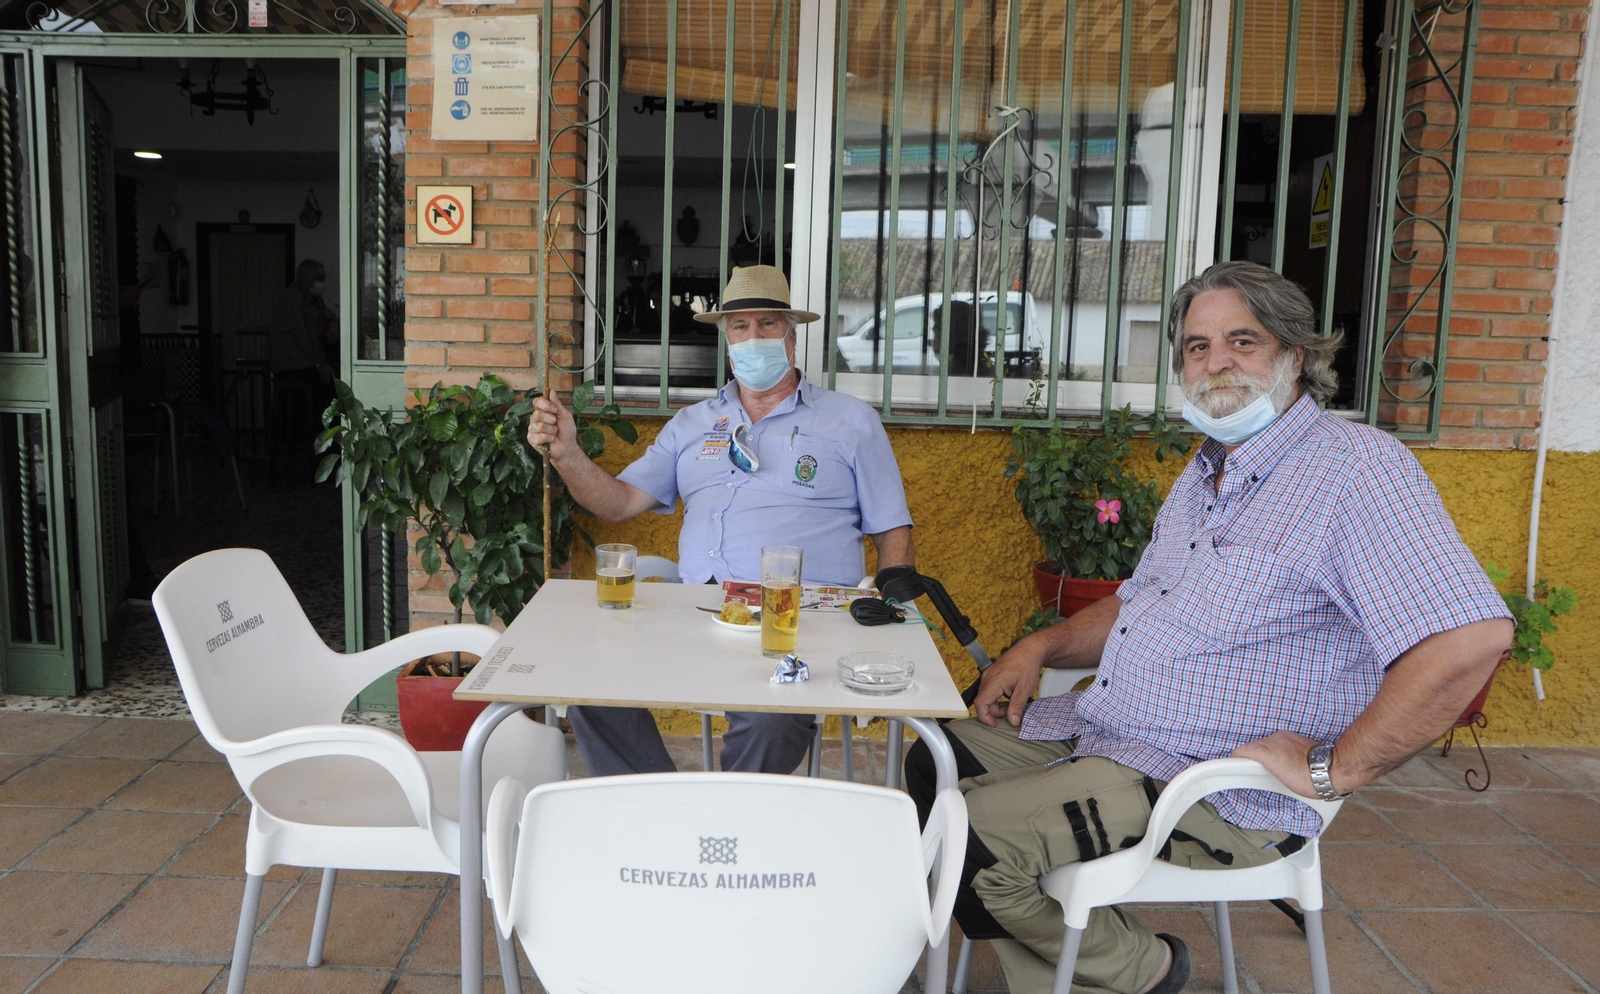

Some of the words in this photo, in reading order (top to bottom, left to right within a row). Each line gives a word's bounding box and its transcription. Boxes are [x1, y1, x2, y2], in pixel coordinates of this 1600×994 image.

[1316, 220, 1329, 231] RIES
[1311, 232, 1328, 243] ELECT
[792, 480, 815, 489] POSADAS
[206, 630, 231, 653] CERVEZAS
[231, 614, 265, 639] ALHAMBRA
[619, 867, 709, 889] CERVEZAS
[715, 872, 817, 889] ALHAMBRA
